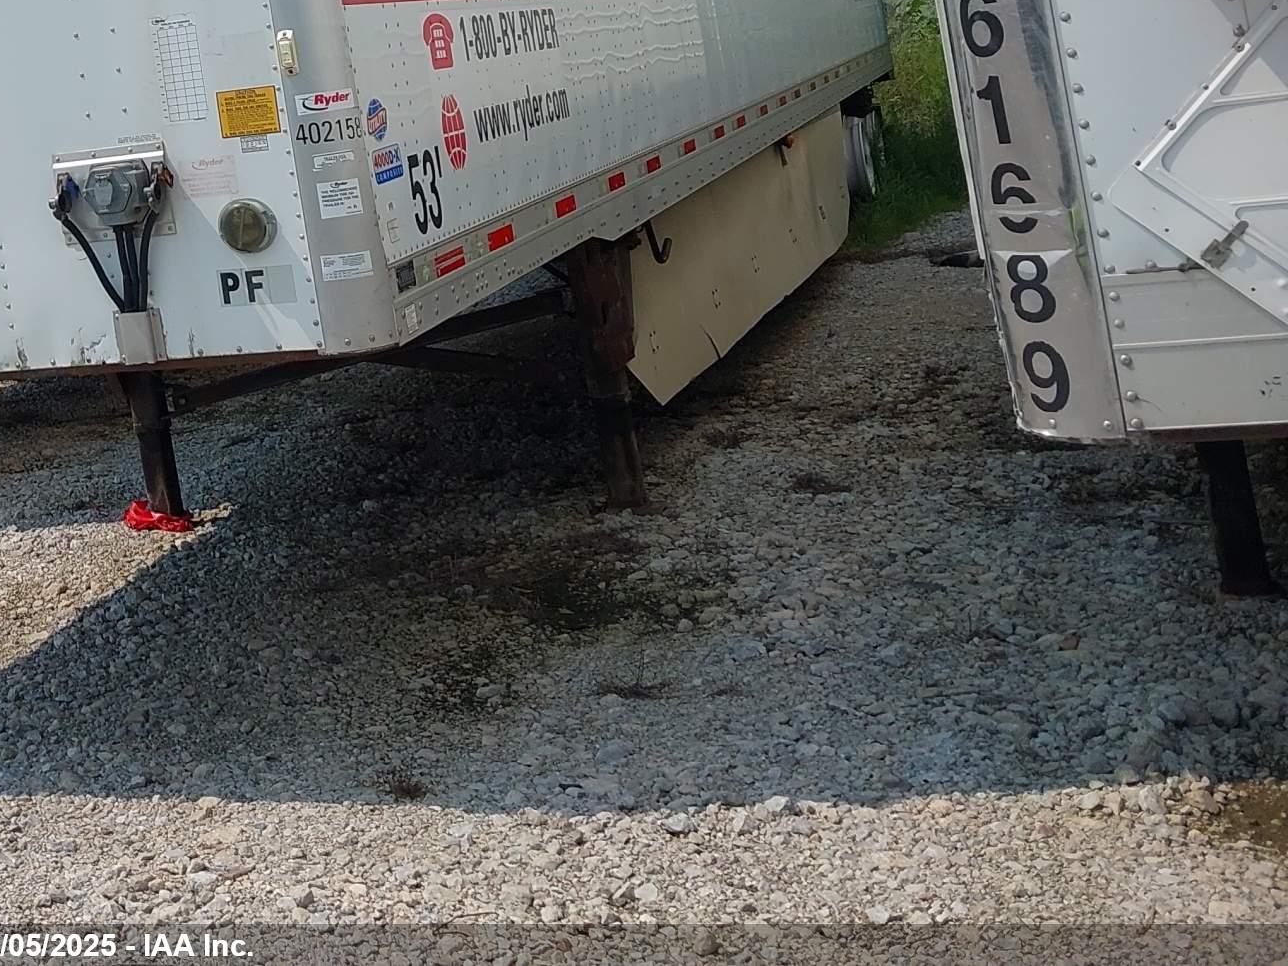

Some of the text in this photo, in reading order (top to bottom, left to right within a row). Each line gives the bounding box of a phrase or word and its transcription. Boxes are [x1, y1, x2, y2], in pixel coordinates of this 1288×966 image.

[459, 7, 561, 62] 1-800-BY-RYDER
[314, 92, 350, 107] Ryder
[472, 84, 571, 144] www.ryder.com
[295, 116, 362, 146] 402158
